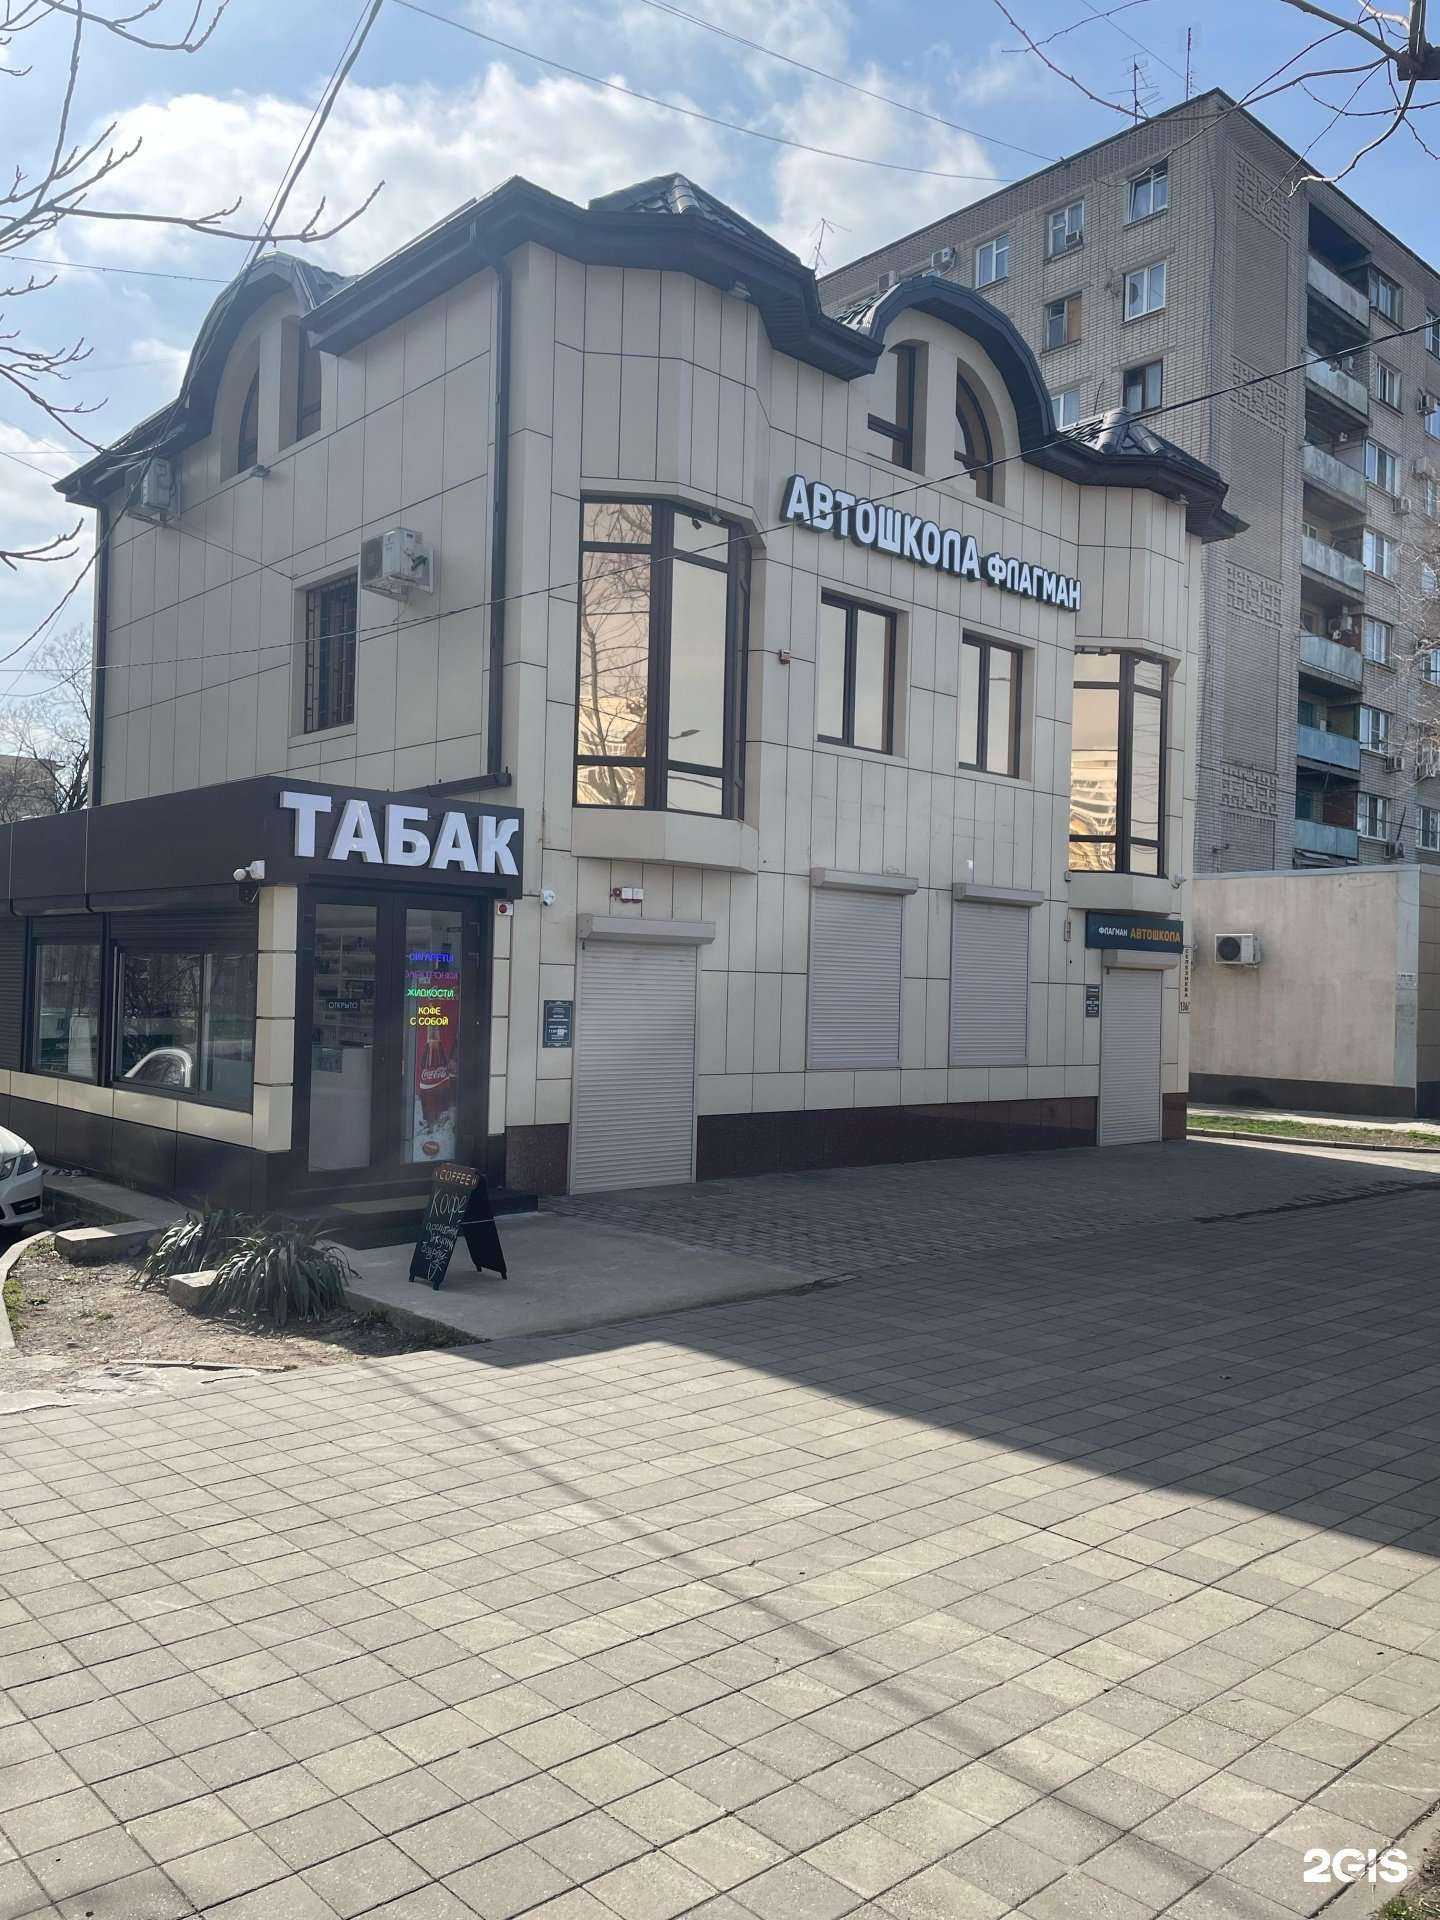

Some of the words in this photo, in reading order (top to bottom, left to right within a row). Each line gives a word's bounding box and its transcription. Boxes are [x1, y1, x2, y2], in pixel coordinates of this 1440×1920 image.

[280, 790, 520, 876] ТАБАК
[407, 988, 454, 998] ЖИДКОСТИ
[418, 1006, 441, 1015] КОФЕ
[409, 1016, 417, 1026] С
[418, 1016, 449, 1026] СОБОЙ
